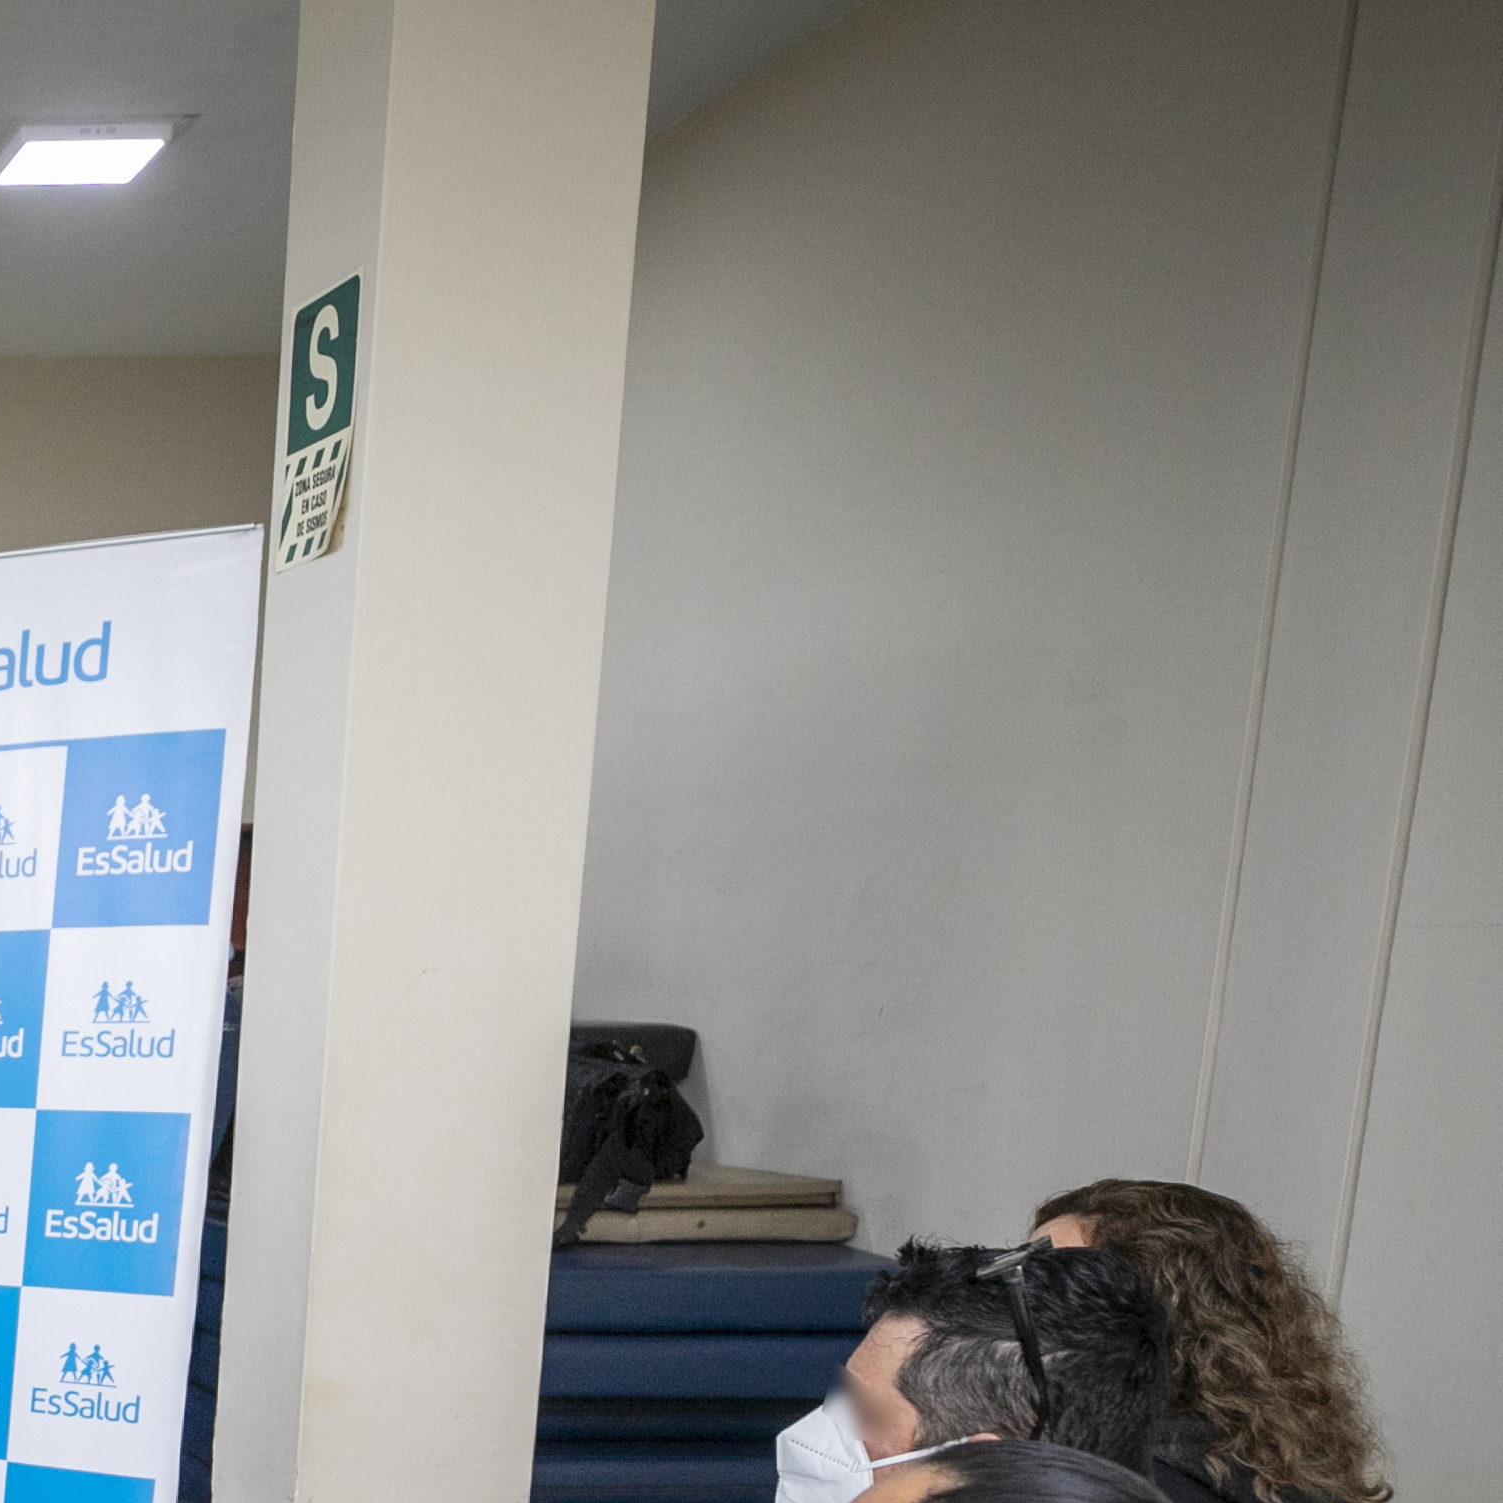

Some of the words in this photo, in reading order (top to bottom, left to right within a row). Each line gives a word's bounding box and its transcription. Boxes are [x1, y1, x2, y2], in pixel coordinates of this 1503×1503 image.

[305, 303, 340, 431] S
[76, 839, 194, 877] EsSalud
[60, 1029, 175, 1060] EsSalud
[43, 1209, 160, 1246] EsSalud
[30, 1387, 142, 1424] EsSalud
